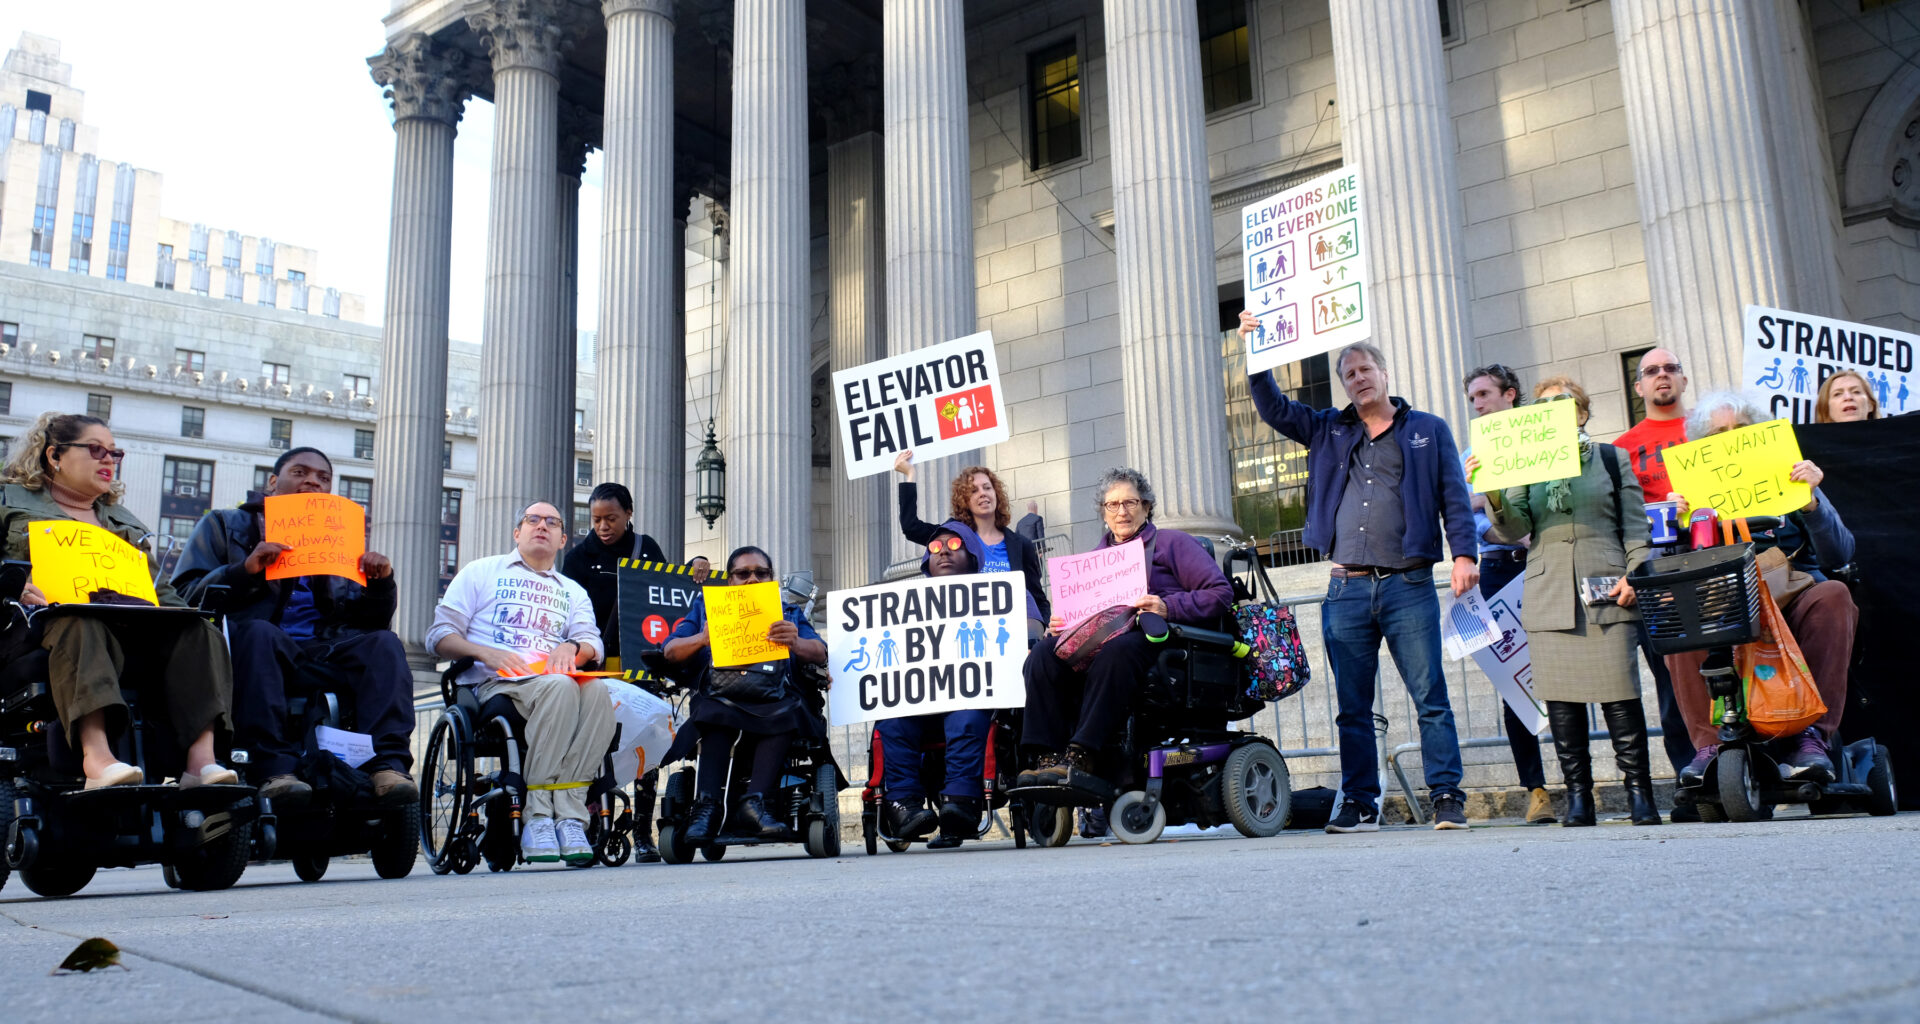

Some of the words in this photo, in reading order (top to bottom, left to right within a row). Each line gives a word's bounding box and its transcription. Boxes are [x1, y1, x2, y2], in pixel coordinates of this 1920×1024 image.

[1246, 187, 1323, 229] ELEVATORS
[1327, 174, 1356, 198] ARE
[1246, 227, 1273, 250] FOR
[1277, 195, 1358, 238] EVERYONE
[1757, 315, 1913, 373] STRANDED
[844, 349, 989, 415] ELEVATOR
[1508, 409, 1553, 428] WANT
[849, 404, 934, 461] FAIL
[1490, 435, 1512, 451] TO
[1675, 444, 1713, 471] WE
[1722, 424, 1781, 456] WANT
[1265, 463, 1287, 475] 60
[1279, 471, 1309, 482] STREE
[1711, 463, 1743, 483] TO
[271, 514, 315, 533] MAKE
[52, 528, 92, 547] WE
[80, 552, 116, 570] TO
[1060, 549, 1125, 580] STATION
[495, 589, 517, 600] FOR
[497, 578, 554, 594] ELEVATORS
[648, 585, 702, 608] ELEV
[710, 605, 733, 619] MAKE
[738, 602, 762, 617] ALL
[842, 581, 1013, 632] STRANDED
[650, 620, 662, 637] F
[714, 620, 750, 639] SUBWAY
[905, 624, 946, 663] BY
[859, 661, 993, 711] CUOMO!
